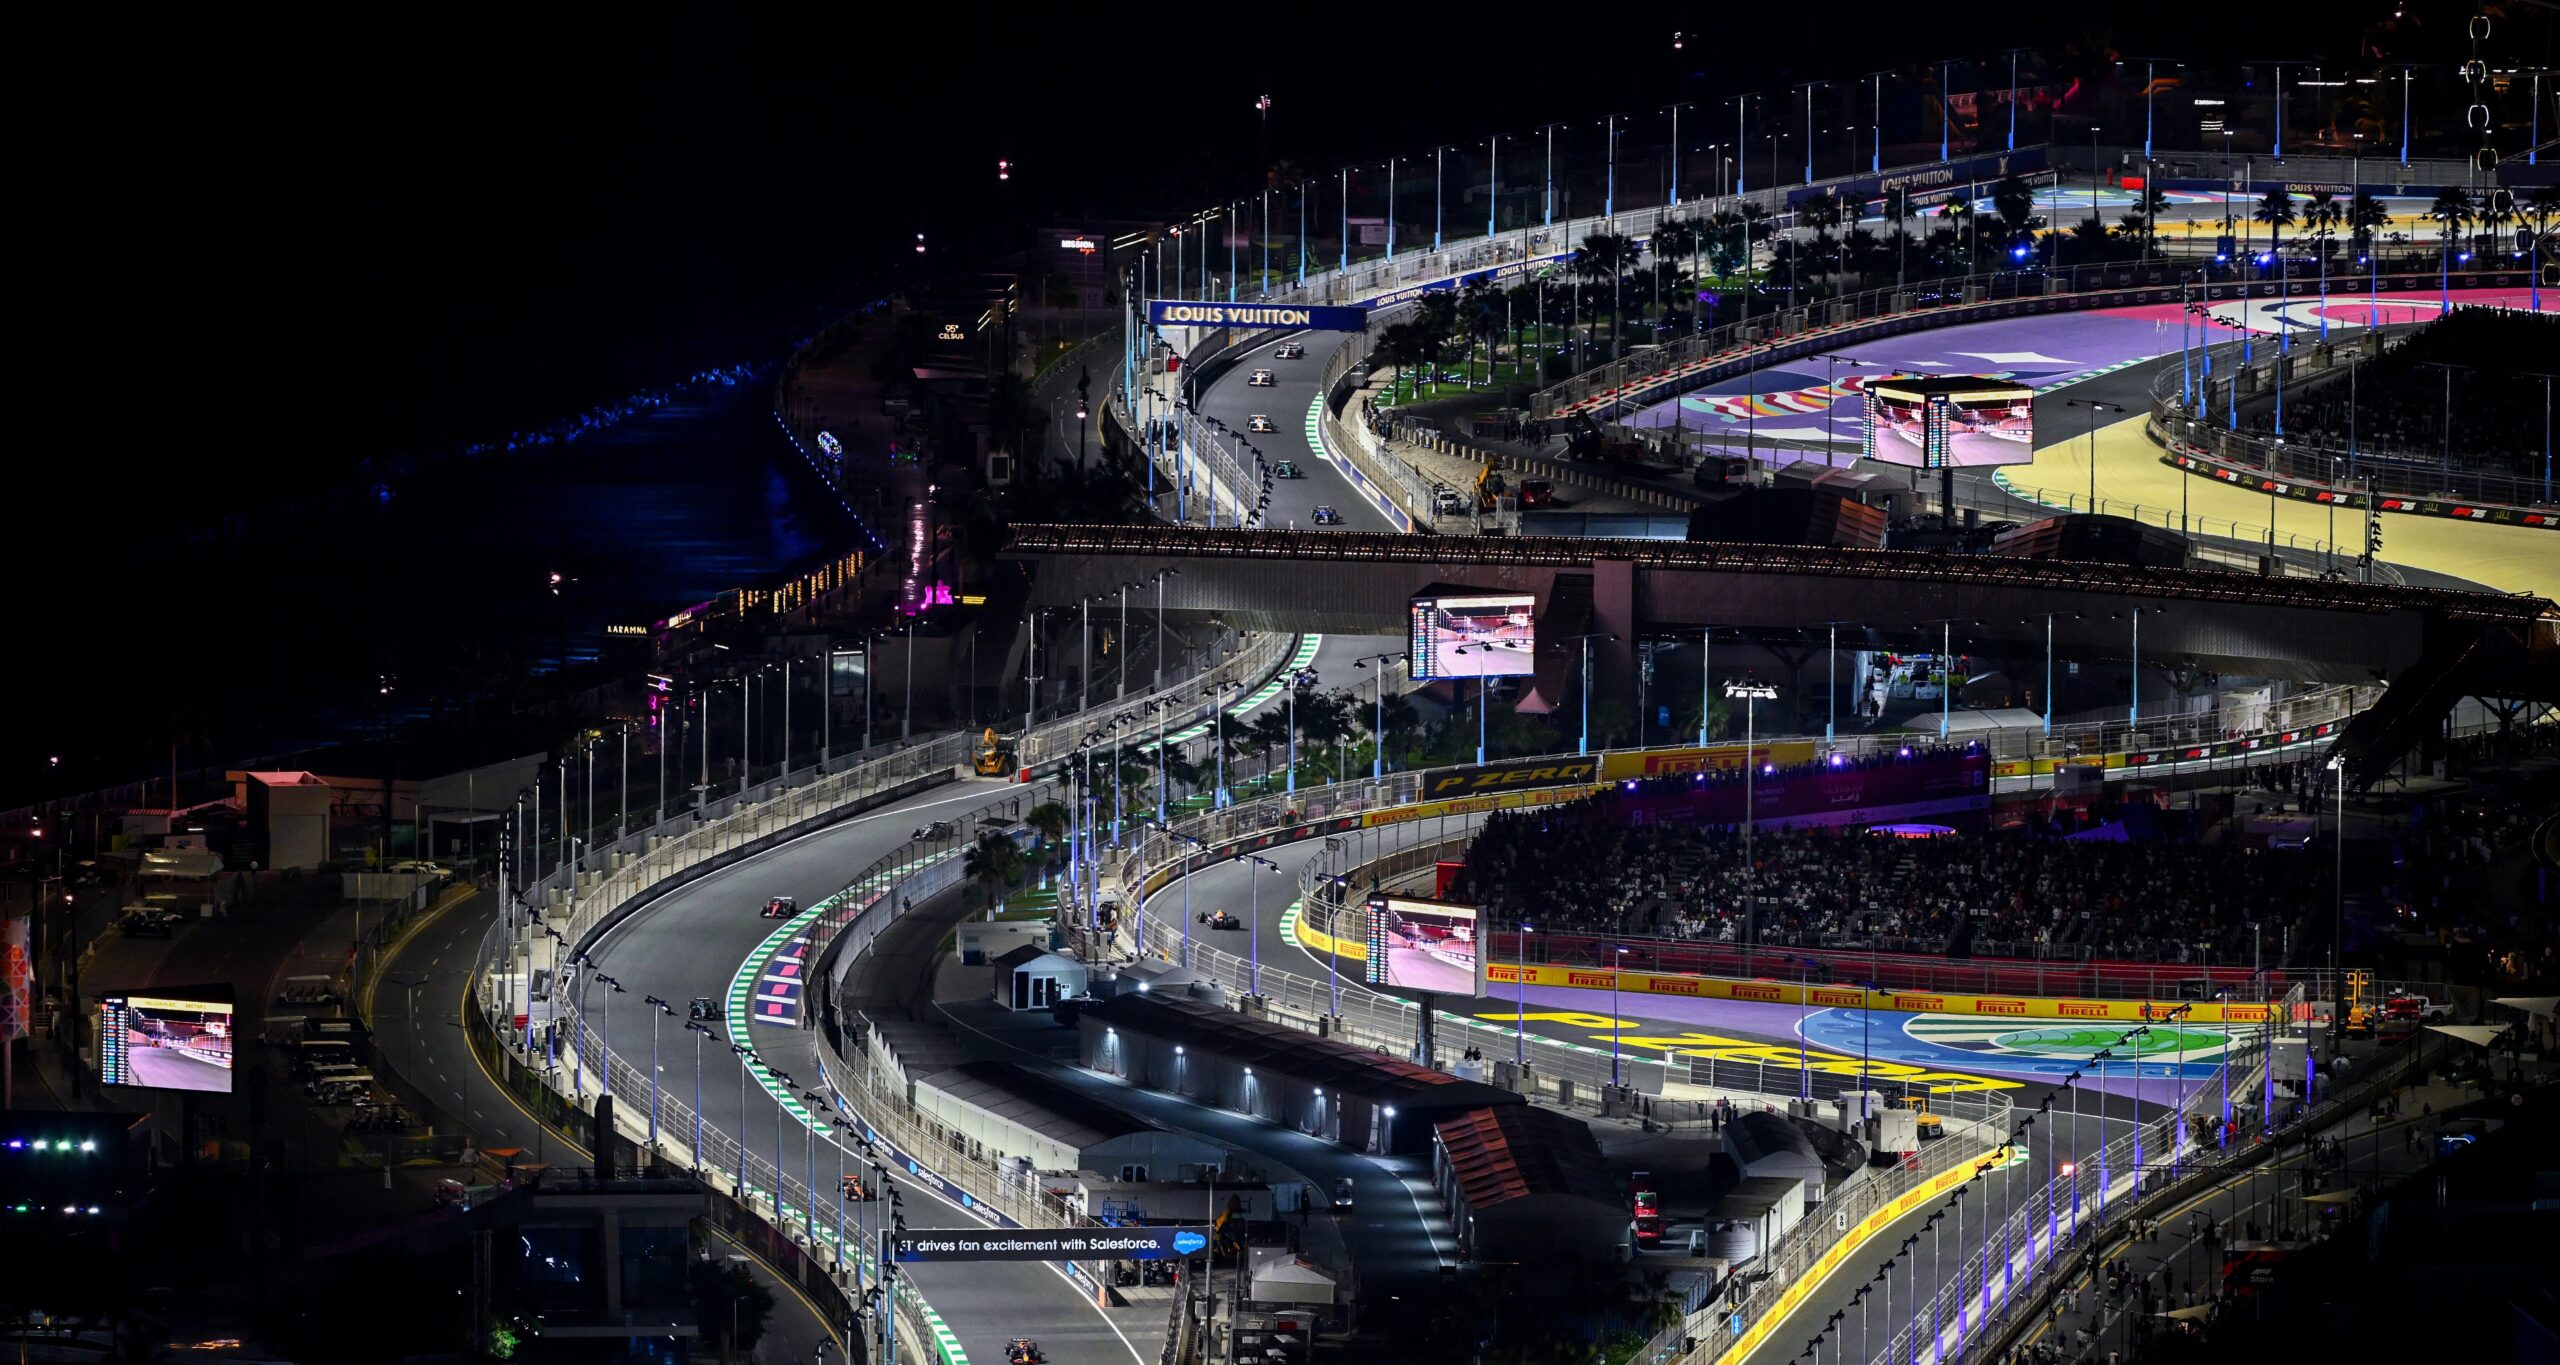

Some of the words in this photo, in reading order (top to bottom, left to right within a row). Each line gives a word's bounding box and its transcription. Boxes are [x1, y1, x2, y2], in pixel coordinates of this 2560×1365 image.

[2285, 183, 2313, 192] LOUIS
[2314, 183, 2353, 193] VUITTON
[1497, 265, 1519, 276] LOUIS
[1376, 296, 1395, 307] LOUIS
[1396, 288, 1423, 304] VUITTON
[1165, 306, 1223, 323] LOUIS
[1226, 308, 1310, 325] VUITTON
[1645, 748, 1770, 774] PIRELLI
[1434, 777, 1466, 792] P
[1471, 763, 1594, 788] ZERO
[1448, 798, 1500, 812] PIRELLI
[1371, 808, 1418, 825] PIRELLI
[1340, 943, 1365, 957] PIRELLI
[1488, 966, 1537, 981] PIRELLI
[1568, 972, 1617, 987] PIRELLI
[1649, 978, 1699, 993] PIRELLI
[1731, 985, 1781, 1000] PIRELLI
[1812, 991, 1862, 1006] PIRELLI
[1894, 996, 1944, 1011] PIRELLI
[1975, 1000, 2026, 1014] PIRELLI
[2058, 1003, 2108, 1017] PIRELLI
[2139, 1006, 2189, 1019] PRELI
[917, 1168, 944, 1190] salesforce
[1936, 1171, 1959, 1190] PIRELLI
[1900, 1190, 1920, 1210] PIRELLI
[972, 1201, 1000, 1223] salesforce
[917, 1240, 956, 1251] drives
[958, 1239, 980, 1251] fan
[984, 1239, 1057, 1251] excitement
[1061, 1238, 1087, 1250] with
[1090, 1238, 1160, 1250] Salesforce.
[1075, 1269, 1094, 1292] salesforce
[2249, 1275, 2275, 1284] Store
